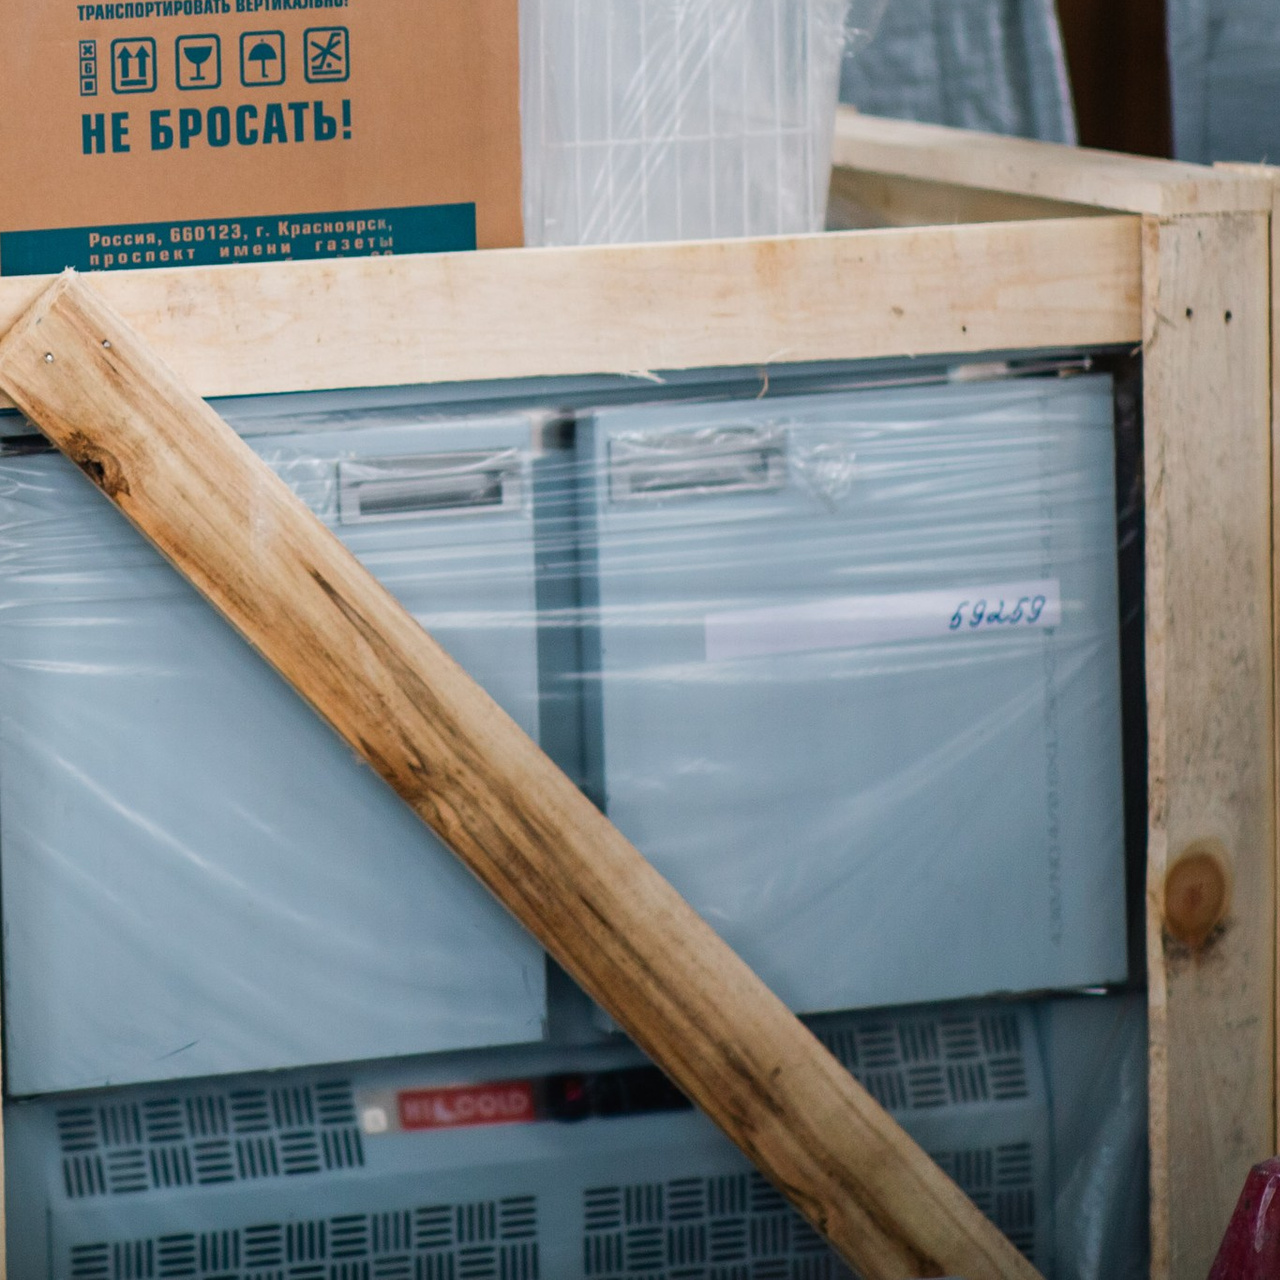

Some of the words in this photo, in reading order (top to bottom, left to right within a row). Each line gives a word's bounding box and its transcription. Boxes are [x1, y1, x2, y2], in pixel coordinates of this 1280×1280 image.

[81, 111, 131, 155] НЕ
[149, 99, 352, 151] БРОСАТЬ!
[89, 231, 163, 248] Россия,
[170, 223, 248, 243] 660123,
[256, 226, 270, 238] г.
[278, 218, 393, 238] Красноярск,
[89, 247, 196, 268] проспект
[220, 241, 292, 259] имени
[315, 236, 394, 252] газеты
